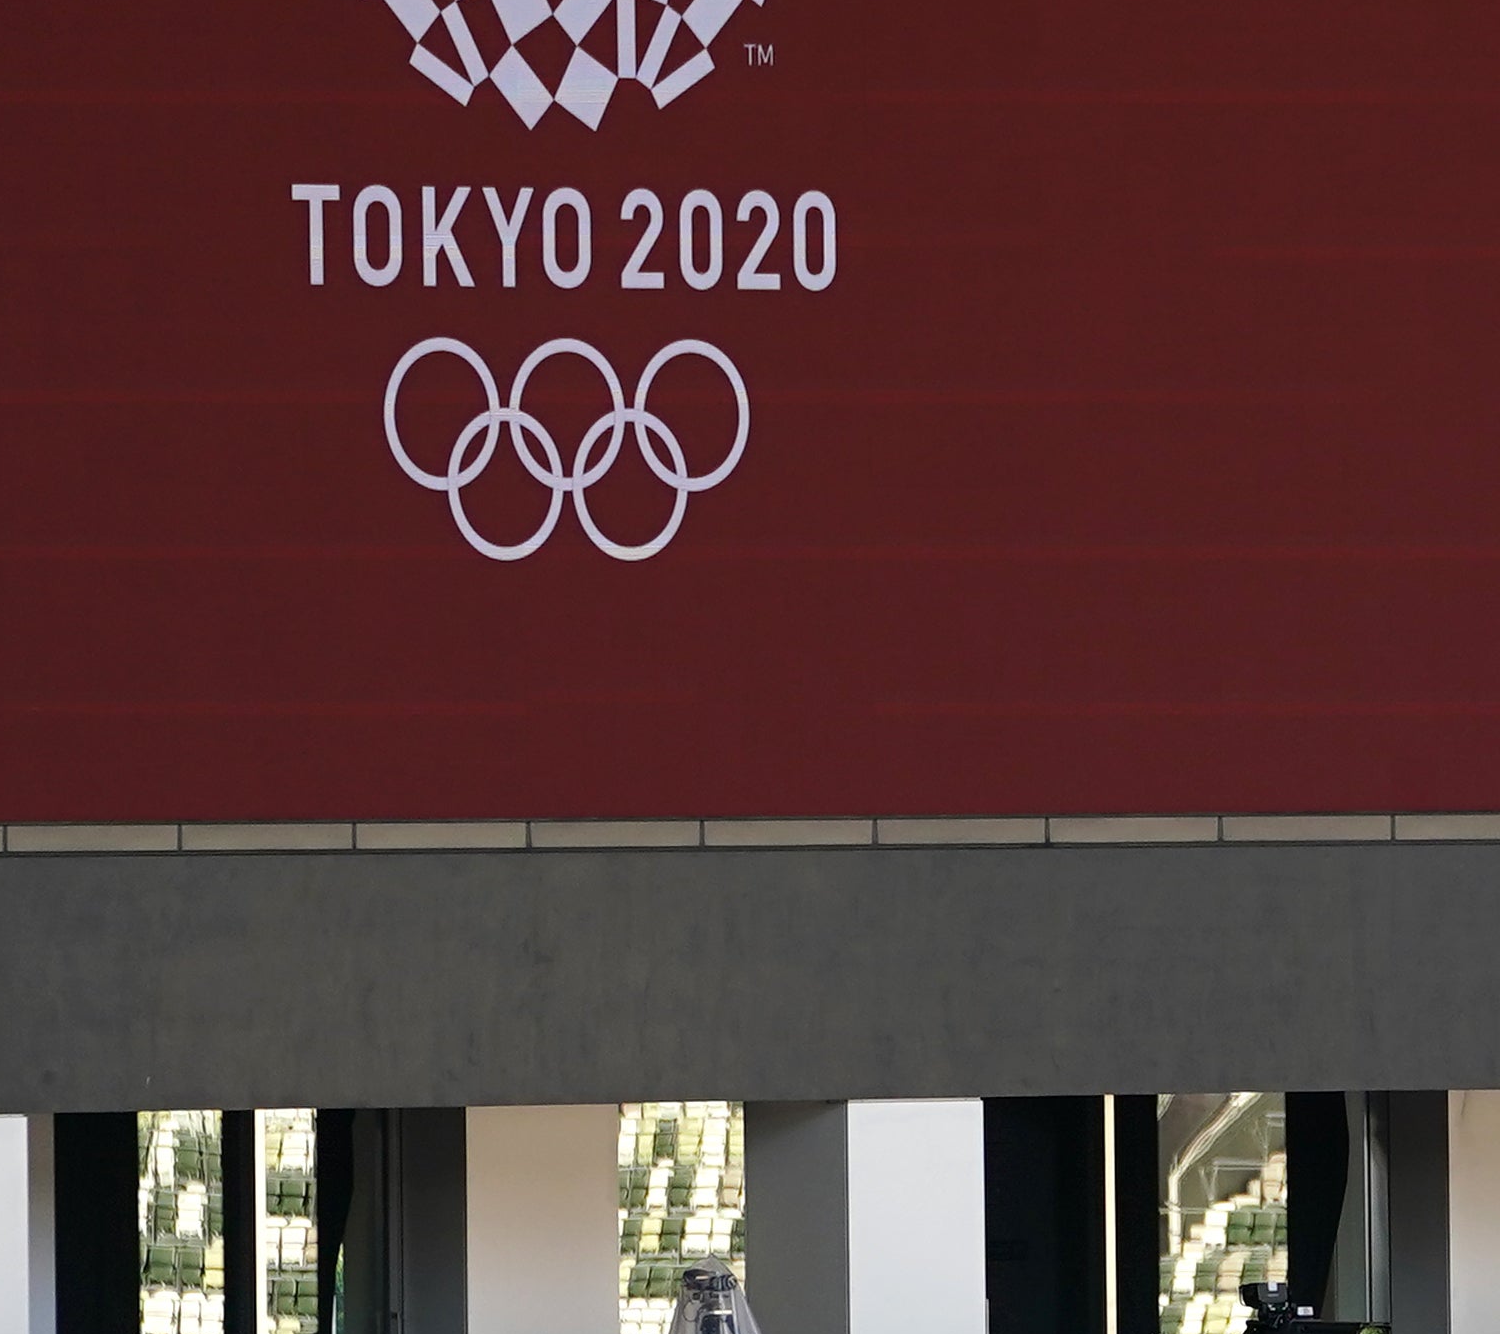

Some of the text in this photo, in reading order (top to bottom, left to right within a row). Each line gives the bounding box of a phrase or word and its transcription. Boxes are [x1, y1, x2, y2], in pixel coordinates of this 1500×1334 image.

[744, 43, 774, 66] TM
[291, 183, 837, 292] TOKYO 2020
